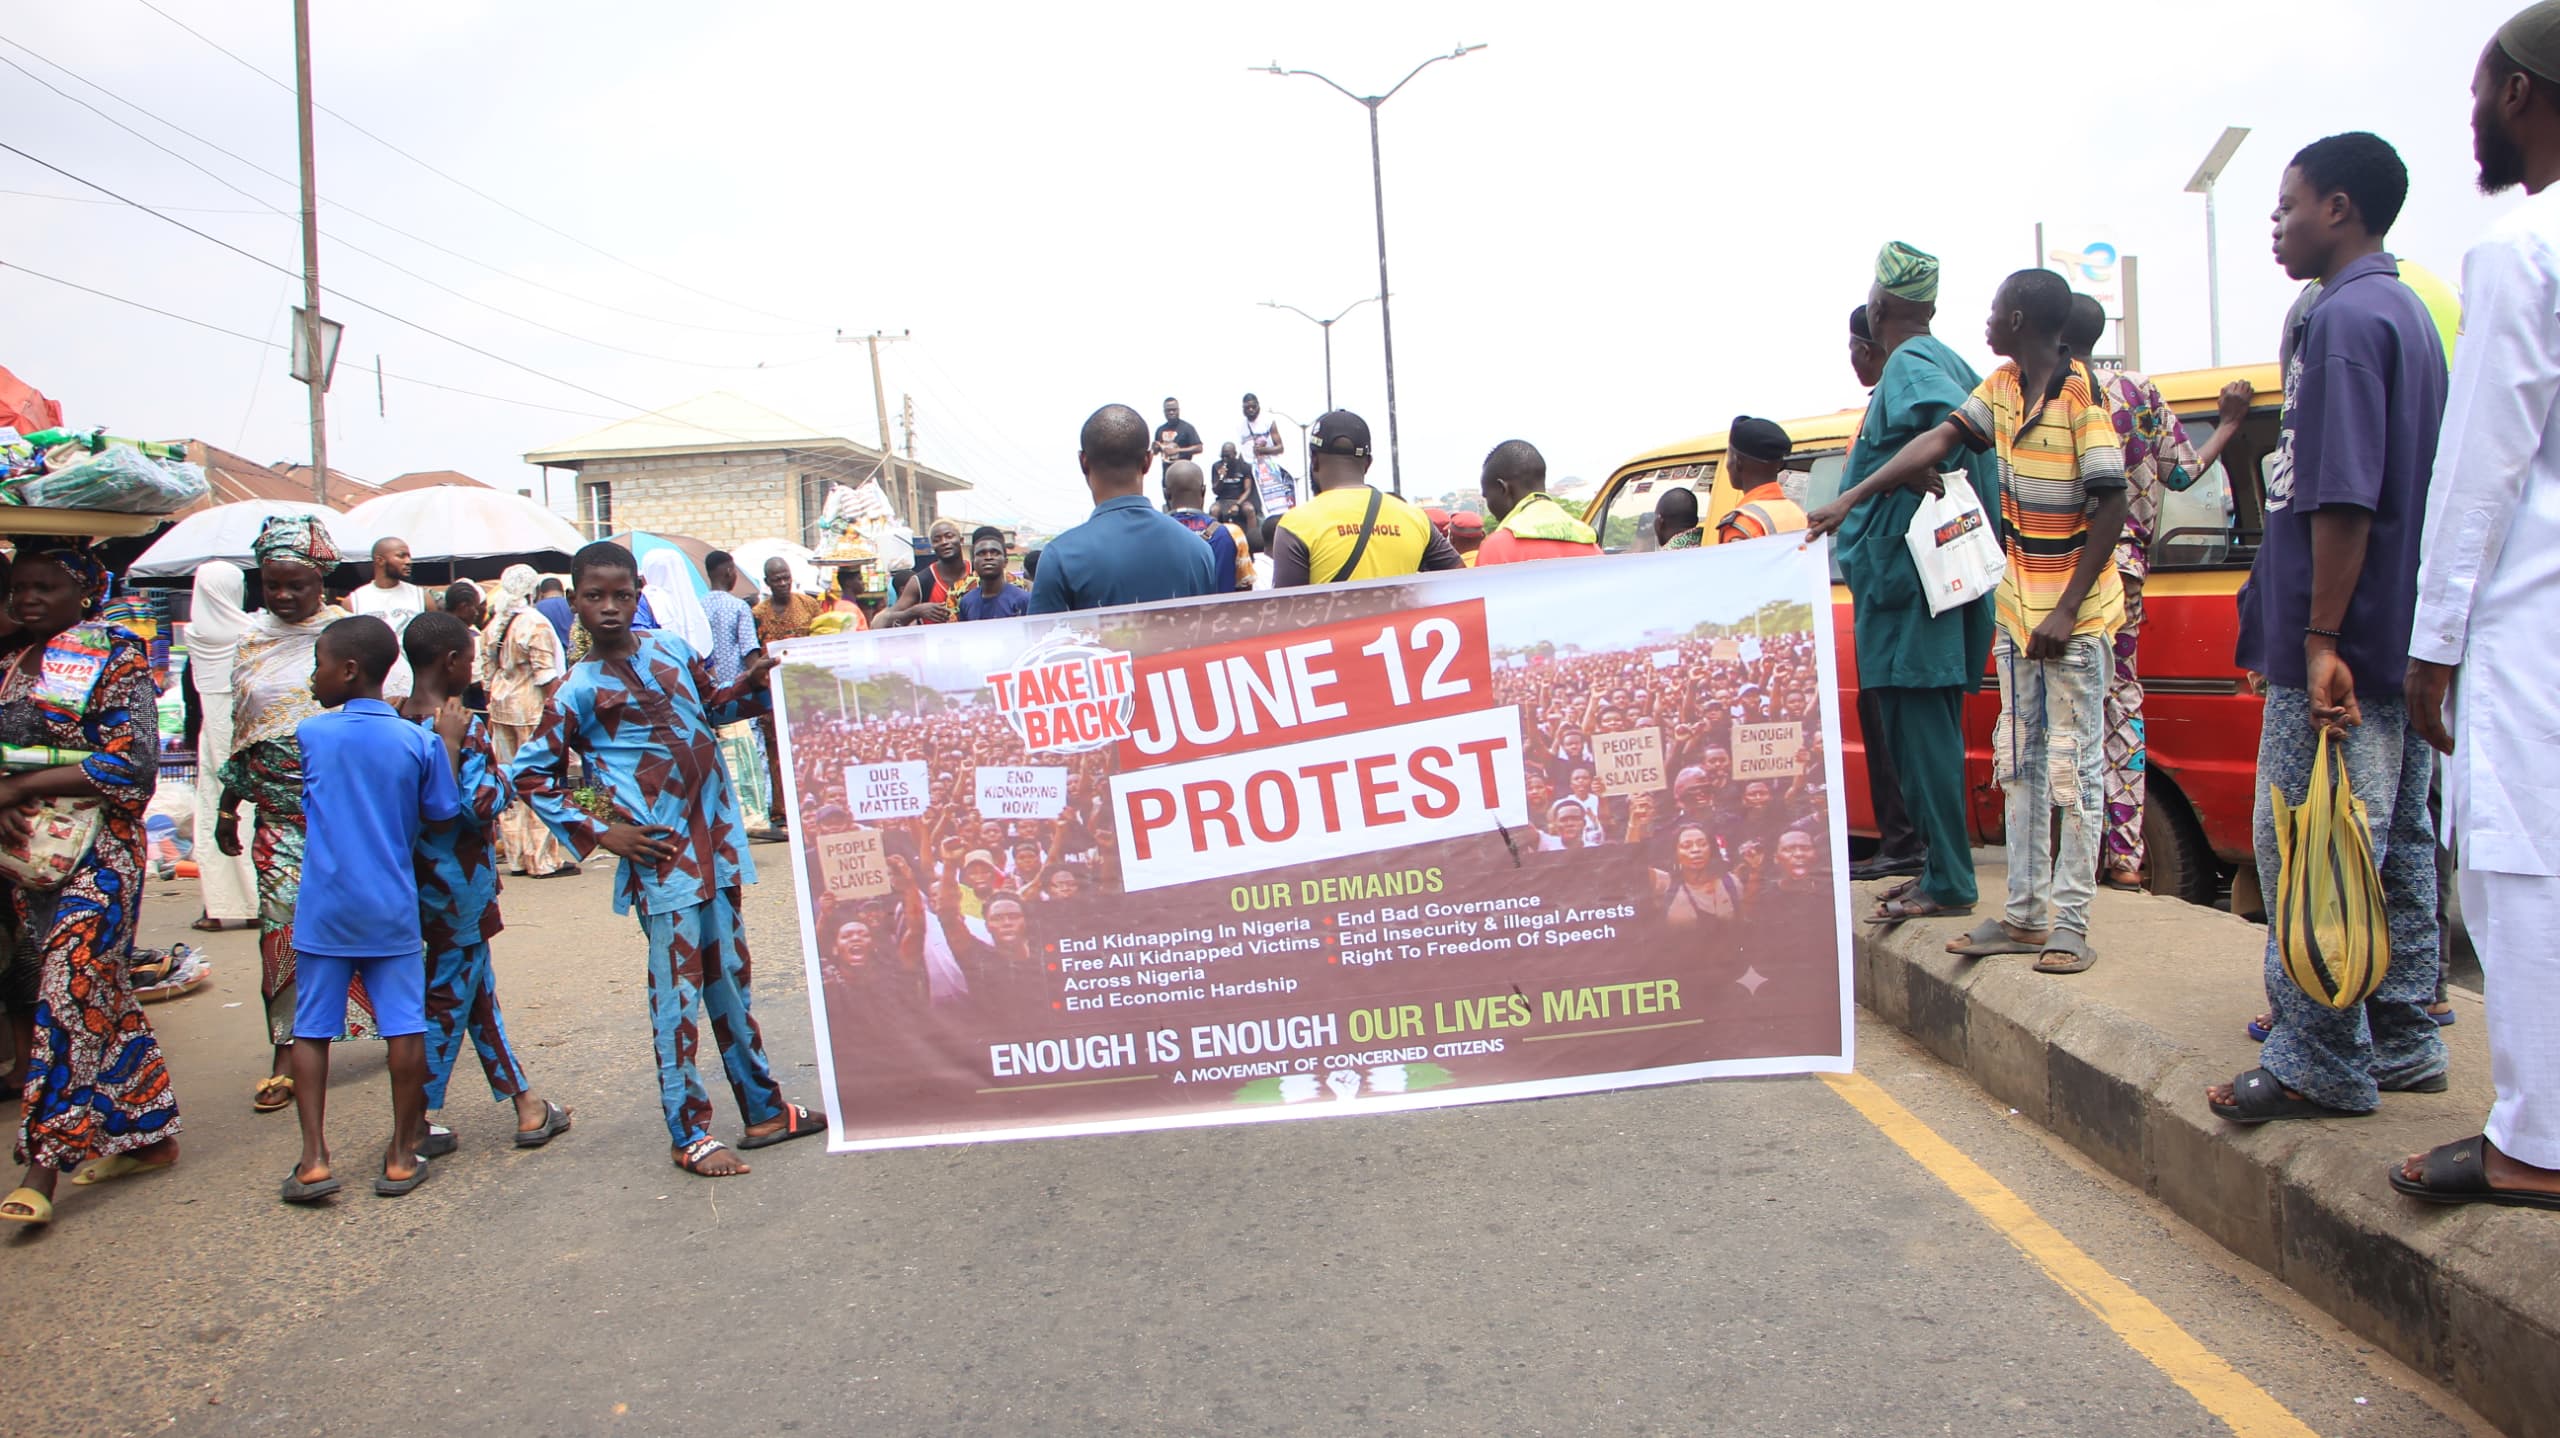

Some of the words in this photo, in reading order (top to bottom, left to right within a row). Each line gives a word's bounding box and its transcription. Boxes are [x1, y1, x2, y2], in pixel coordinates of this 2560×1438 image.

[43, 661, 95, 675] SUPA
[986, 662, 1088, 712] TAKE
[1093, 655, 1130, 697] IT
[1132, 639, 1348, 756] JUNE
[1361, 617, 1471, 706] 12
[1024, 698, 1126, 750] BACK
[1602, 736, 1654, 754] PEOPLE
[1740, 727, 1793, 743] ENOUGH
[1760, 744, 1773, 756] IS
[1615, 753, 1643, 769] NOT
[1740, 758, 1793, 773] ENOUGH
[870, 768, 900, 783] OUR
[1006, 771, 1034, 784] END
[1605, 768, 1659, 786] SLAVES
[866, 784, 909, 799] LIVES
[984, 786, 1058, 799] KIDNAPPING
[1126, 737, 1507, 860] PROTEST
[859, 797, 920, 814] MATTER
[1001, 801, 1040, 814] NOW!
[827, 838, 877, 858] PEOPLE
[838, 856, 866, 872] NOT
[830, 870, 884, 890] SLAVES
[1231, 883, 1292, 912] OUR
[1301, 867, 1444, 906] DEMANDS
[1337, 909, 1376, 927] End
[1381, 905, 1419, 922] Bad
[1425, 895, 1541, 918] Governance
[1059, 936, 1097, 953] End
[1103, 927, 1213, 949] Kidnapping
[1218, 923, 1236, 938] In
[1242, 917, 1311, 937] Nigeria
[1340, 929, 1377, 946] End
[1383, 919, 1478, 942] Insecurity
[1483, 917, 1498, 932] &
[1565, 904, 1635, 923] Arrests
[1061, 956, 1104, 972] Free
[1108, 952, 1135, 968] All
[1140, 942, 1243, 965] Kidnapped
[1248, 935, 1320, 955] Victims
[1341, 948, 1393, 967] Right
[1397, 944, 1421, 959] To
[1427, 934, 1511, 956] Freedom
[1517, 931, 1540, 947] Of
[1545, 925, 1616, 946] Speech
[1064, 974, 1131, 992] Across
[1137, 967, 1205, 987] Nigeria
[1066, 995, 1103, 1012] End
[1109, 985, 1205, 1008] Economic
[1210, 977, 1298, 998] Hardship
[990, 1033, 1136, 1077] ENOUGH
[1147, 1029, 1180, 1063] IS
[1191, 1013, 1338, 1059] ENOUGH
[1349, 1004, 1424, 1043] OUR
[1434, 993, 1532, 1034] LIVES
[1542, 979, 1681, 1024] MATTER
[1173, 1070, 1187, 1084] A
[1192, 1061, 1290, 1083] MOVEMENT
[1294, 1058, 1318, 1072] OF
[1323, 1046, 1428, 1070] CONCERNED
[1433, 1038, 1505, 1058] CITIZENS
